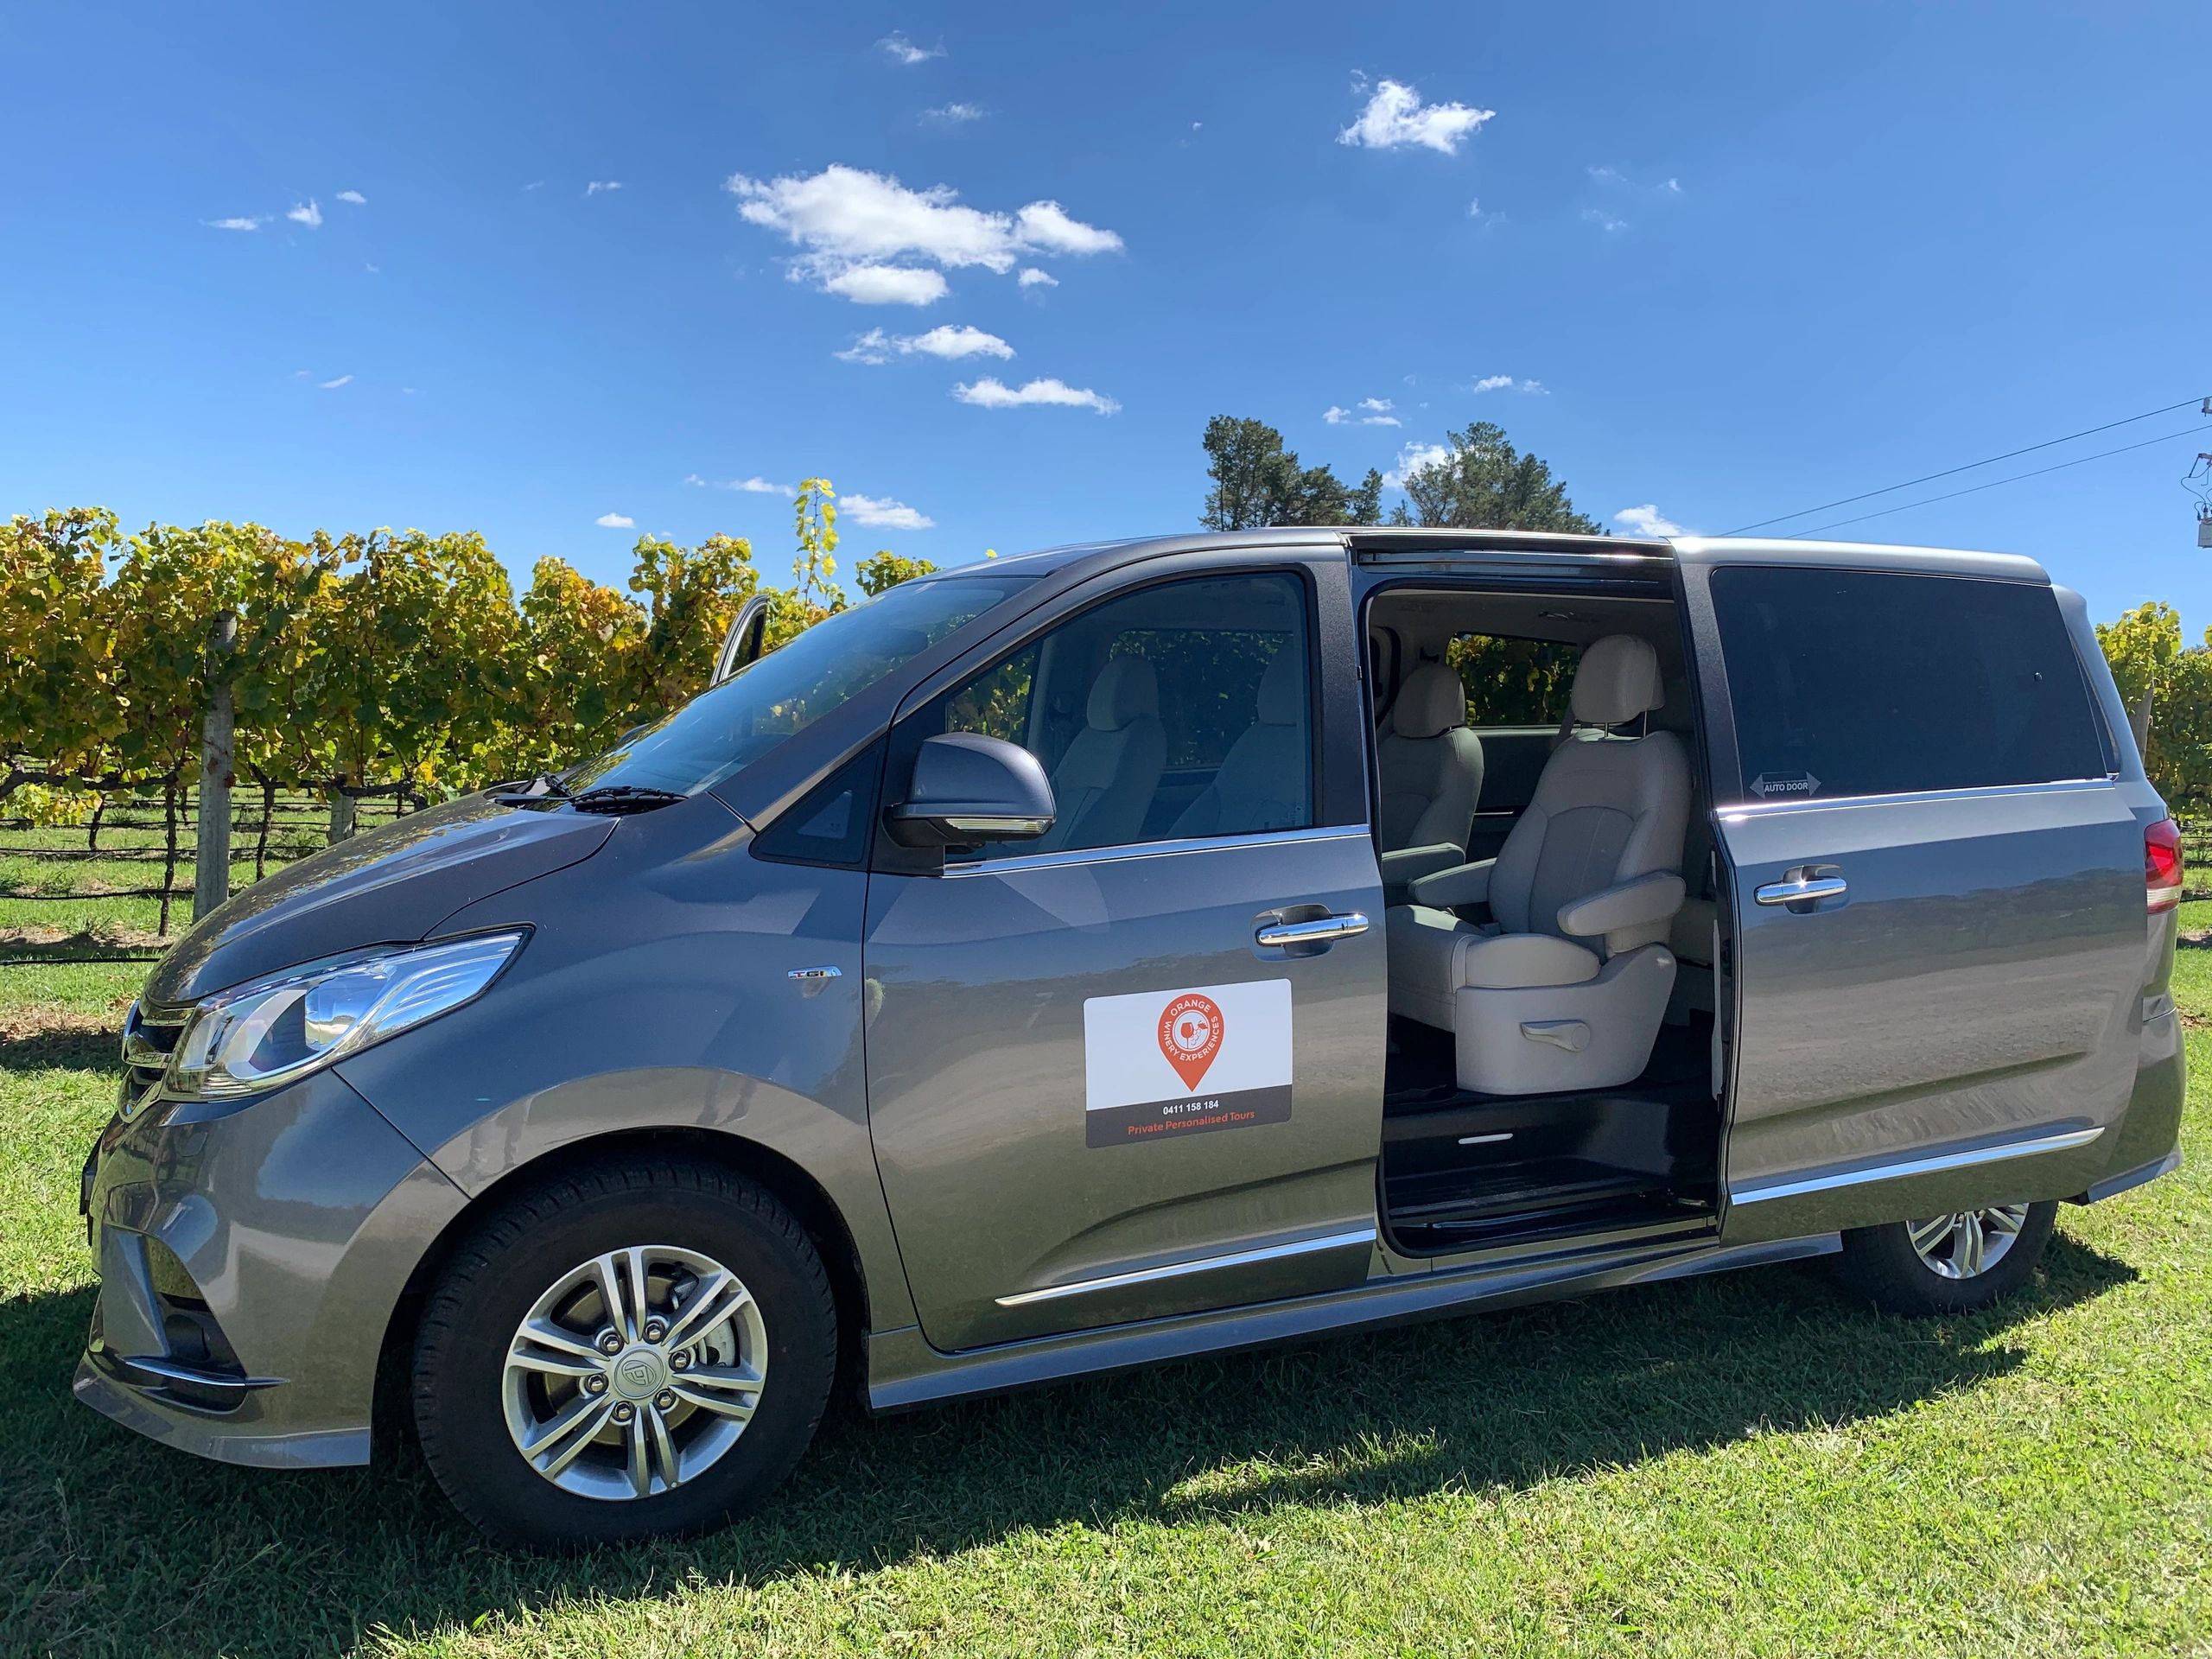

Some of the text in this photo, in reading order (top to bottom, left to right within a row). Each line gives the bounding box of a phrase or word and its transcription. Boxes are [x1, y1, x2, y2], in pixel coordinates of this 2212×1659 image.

[1764, 784, 1785, 792] AUTO
[1787, 782, 1808, 791] DOOR
[1170, 999, 1211, 1016] ORANGE
[1164, 1015, 1219, 1061] WINERY EXPERIENCES
[1163, 1100, 1219, 1115] 0411 158 184
[1128, 1111, 1255, 1135] Private Personalised Tours
